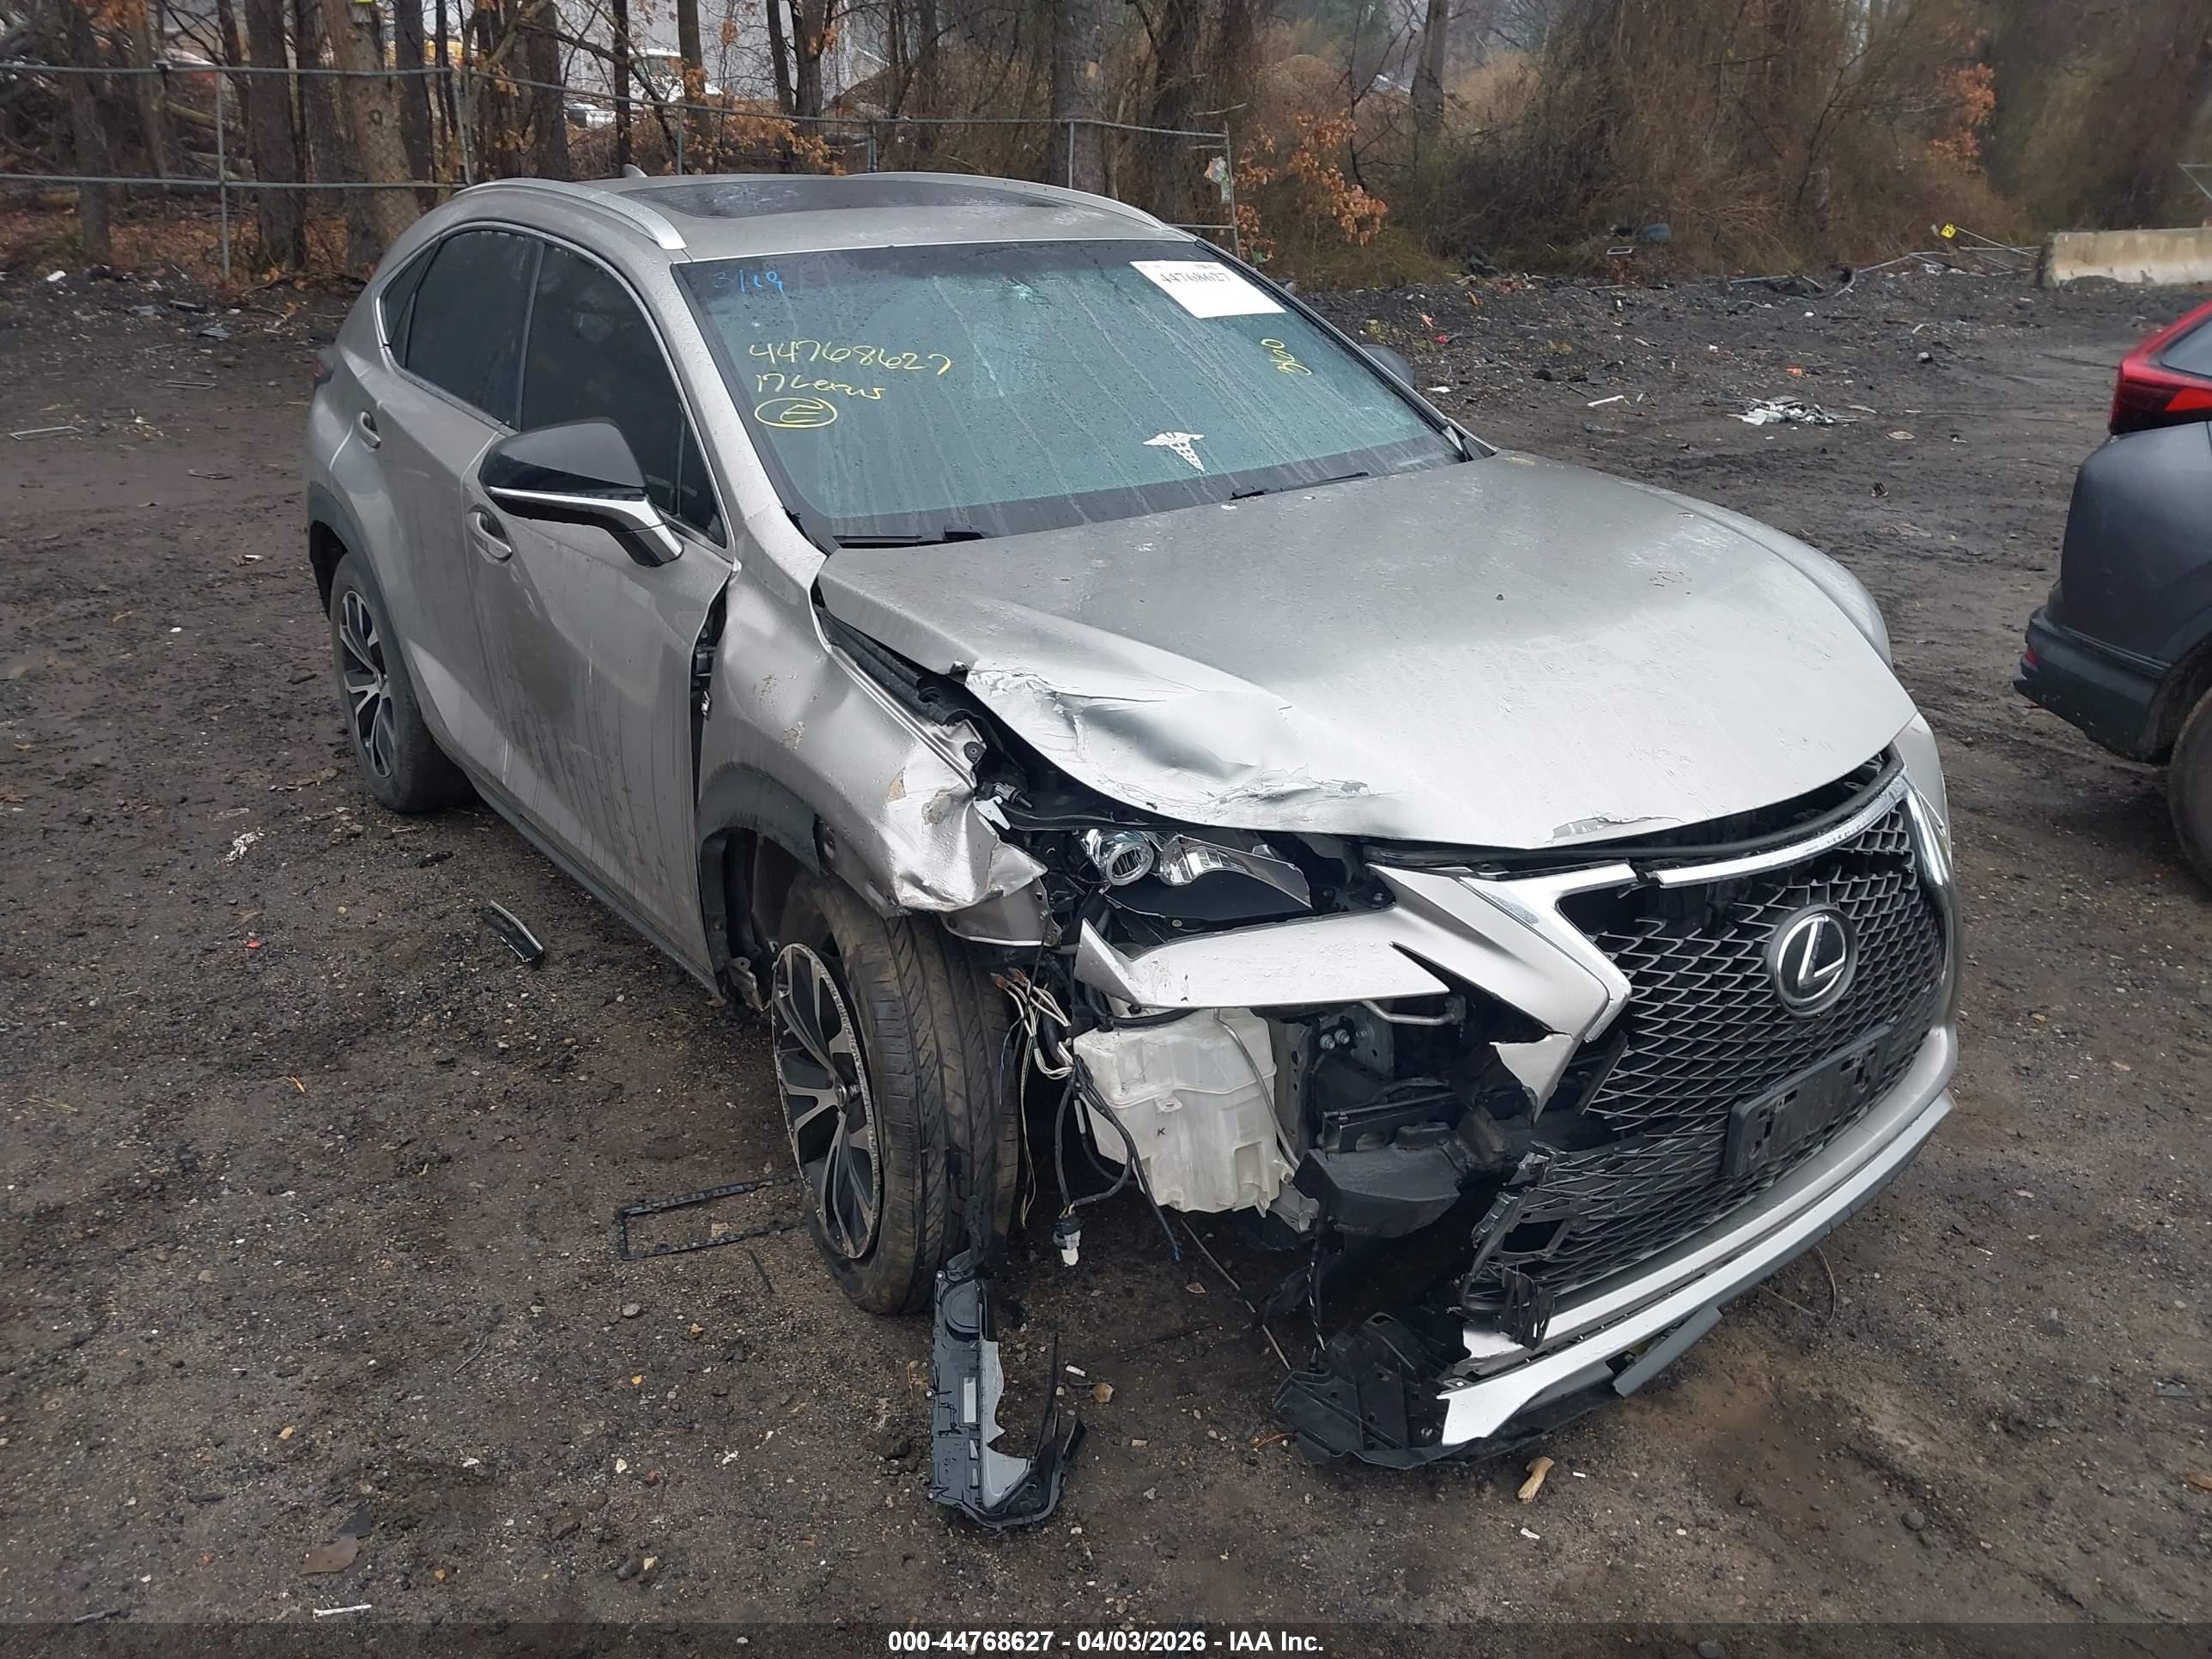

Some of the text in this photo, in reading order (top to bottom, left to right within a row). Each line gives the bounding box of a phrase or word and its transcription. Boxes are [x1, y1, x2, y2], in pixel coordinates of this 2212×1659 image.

[1159, 271, 1231, 283] 44768627
[749, 339, 955, 375] 44768627
[756, 374, 785, 392] 17
